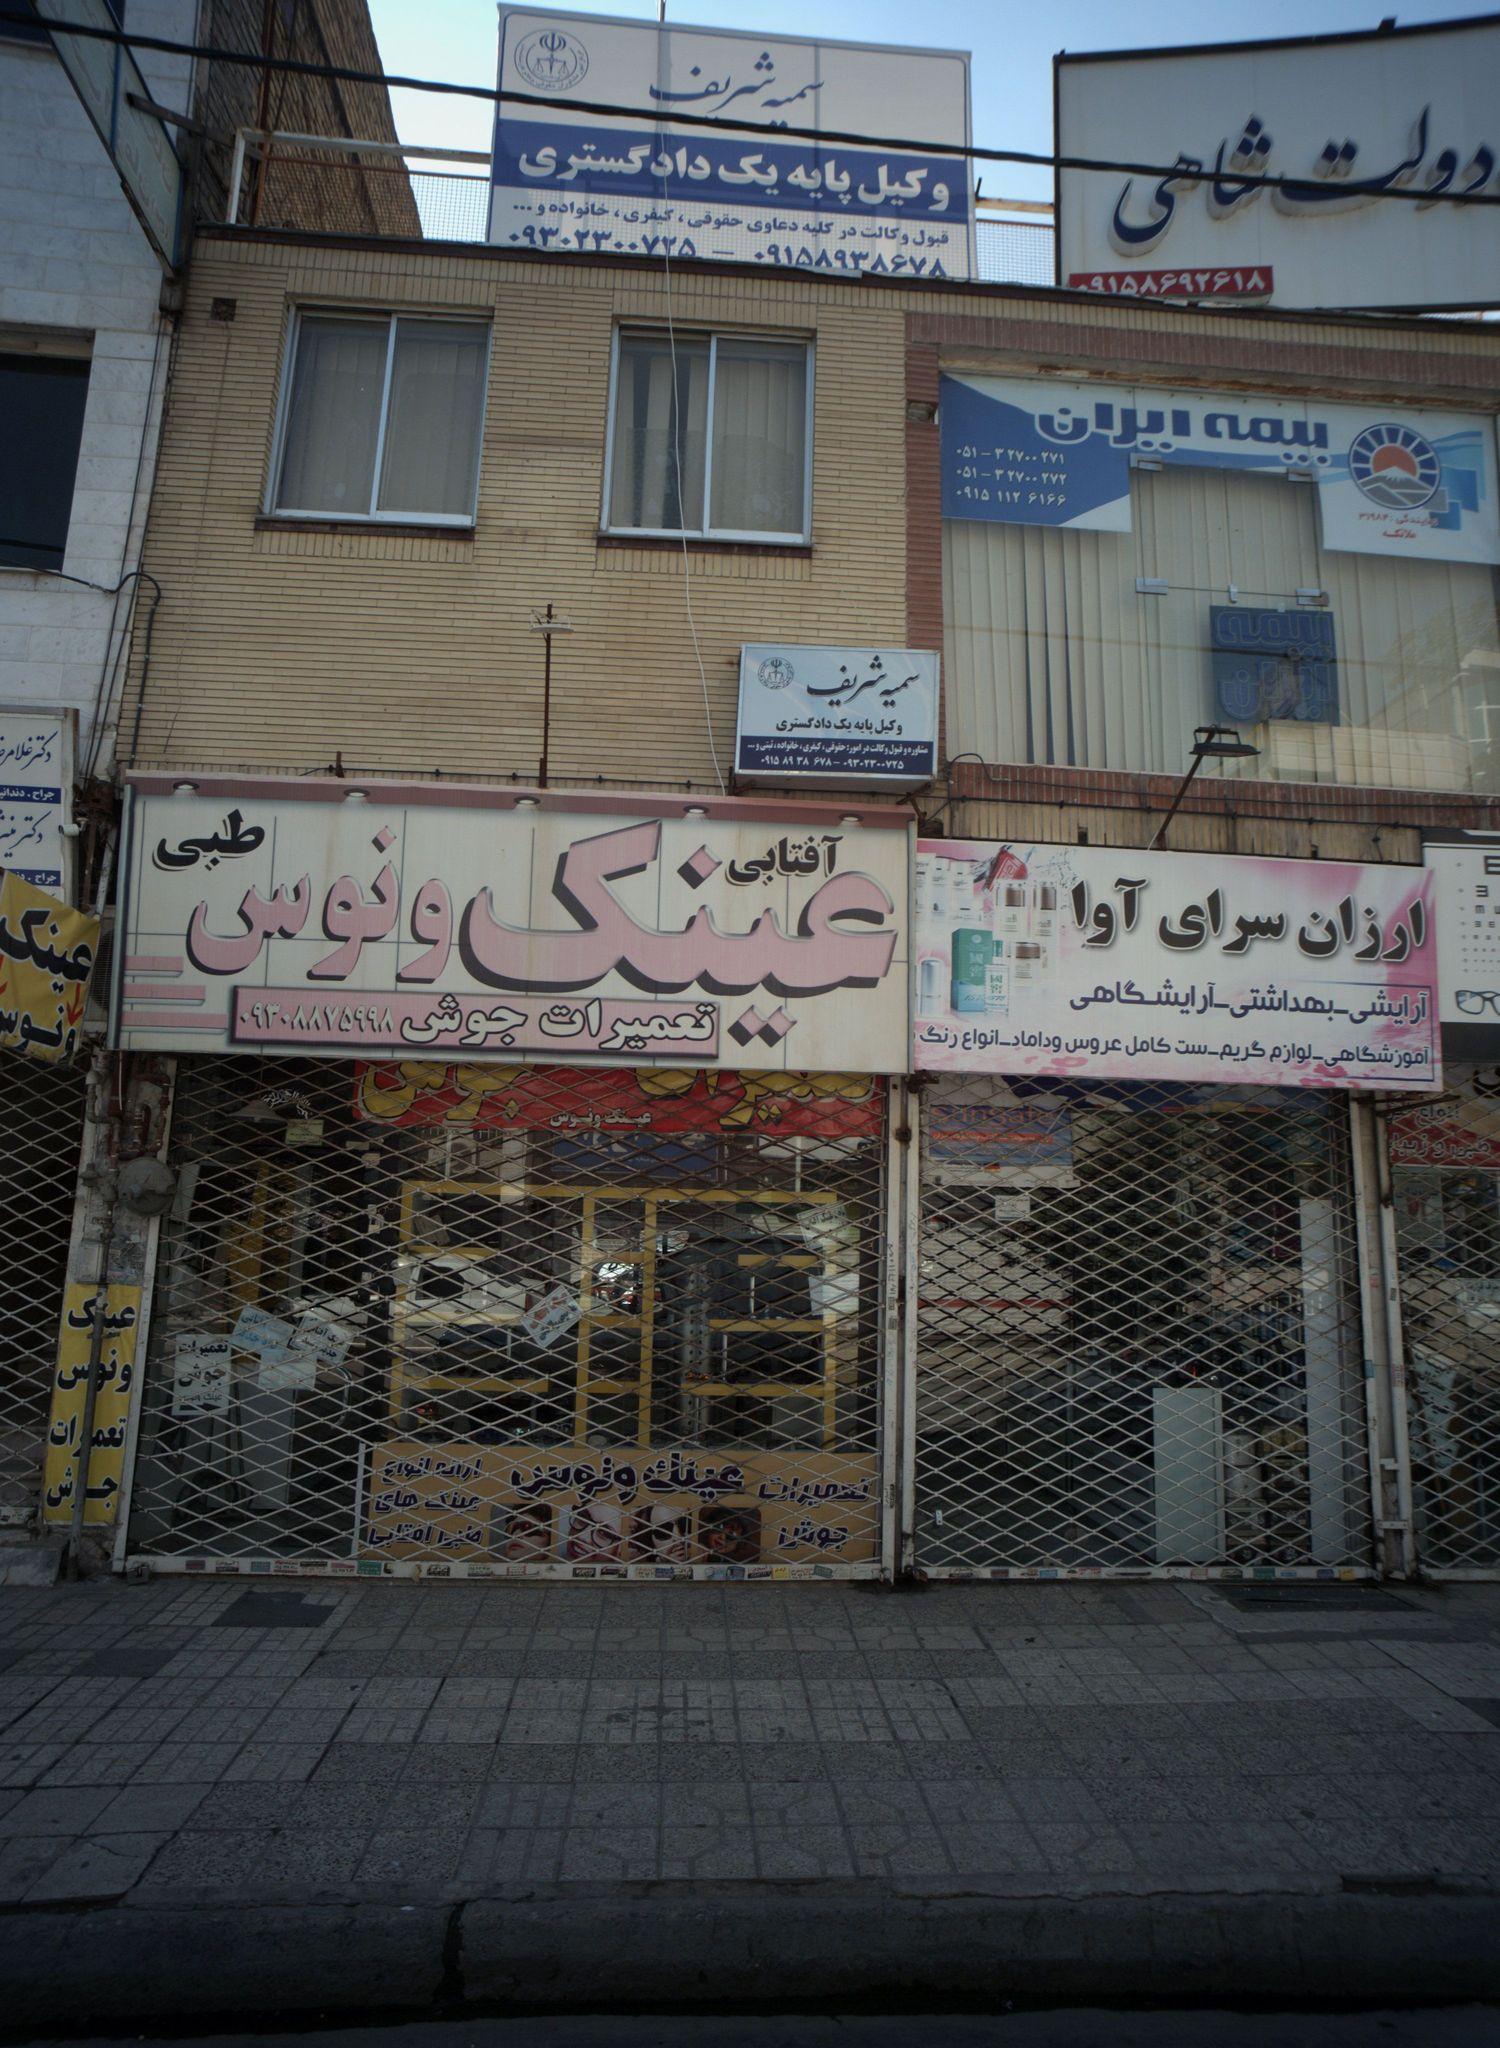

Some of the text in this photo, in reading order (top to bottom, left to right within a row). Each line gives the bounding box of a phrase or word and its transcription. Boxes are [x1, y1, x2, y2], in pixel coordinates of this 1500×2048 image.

[518, 143, 950, 212] وکیل پایه یک دادگستری
[537, 202, 546, 217] و
[549, 200, 609, 219] خانواده
[746, 216, 799, 235] دعاوی
[802, 221, 834, 238] کلیه
[838, 225, 857, 240] در
[912, 230, 949, 248] قبول
[1034, 400, 1333, 467] بیمه ایران
[776, 716, 903, 736] وکیل پایه یک دادگستری
[20, 730, 59, 771] دکتر
[32, 788, 55, 801] جراح
[9, 810, 52, 851] دکتر
[151, 808, 844, 887] طبی آفتابی
[1070, 876, 1426, 962] ارزان سرای آوا
[185, 818, 899, 1048] عینک ونوس
[240, 993, 717, 1051] تعمیرات جوش ۰۹۳۰۸۸۷۵۹۹۸
[919, 1025, 958, 1048] رنگ
[1065, 1036, 1122, 1055] عروس
[1124, 1035, 1173, 1056] کامل
[49, 1415, 127, 1458] تعمرات
[46, 1466, 119, 1508] جش
